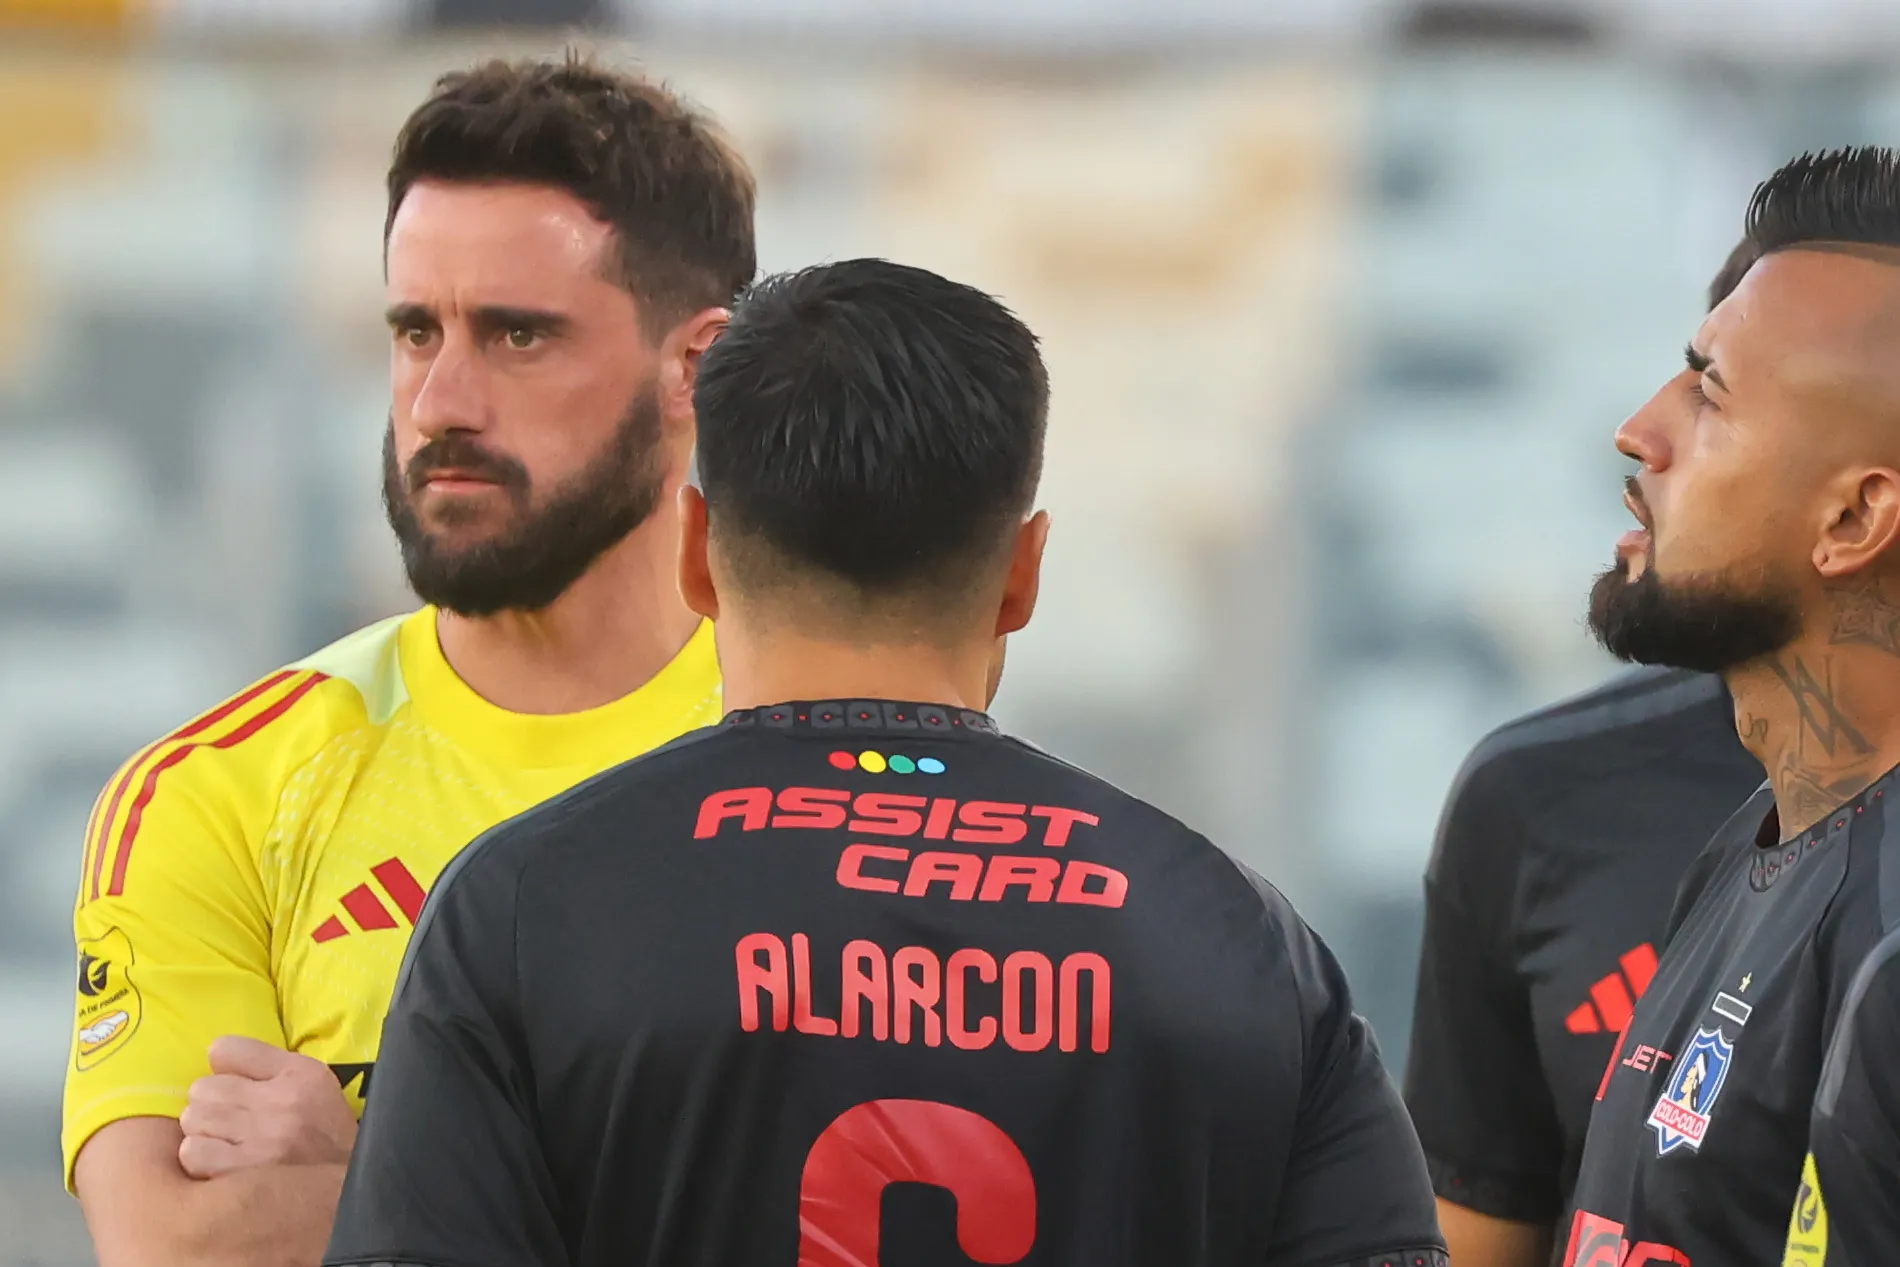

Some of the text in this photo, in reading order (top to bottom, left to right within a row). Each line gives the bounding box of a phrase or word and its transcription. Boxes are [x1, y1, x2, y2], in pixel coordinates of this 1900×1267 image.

[693, 786, 1099, 847] ASSIST
[836, 844, 1128, 908] CARD
[735, 932, 1111, 1053] ALARCON
[1655, 1102, 1704, 1138] COLO-COLO
